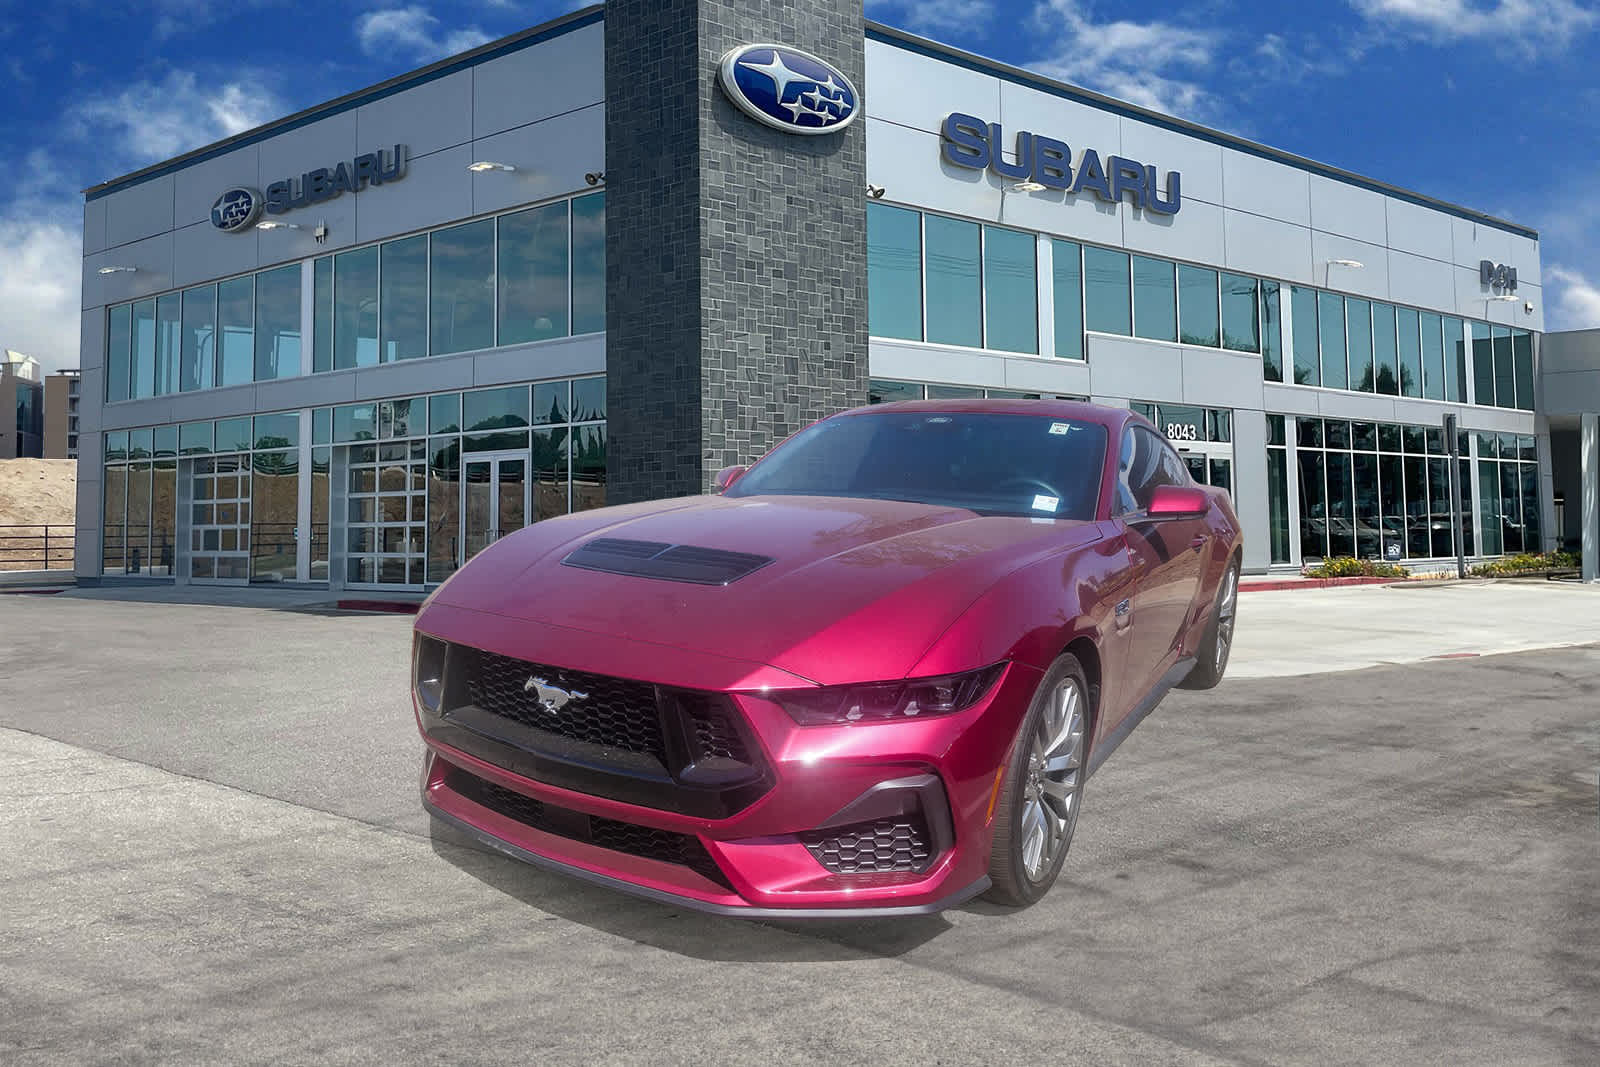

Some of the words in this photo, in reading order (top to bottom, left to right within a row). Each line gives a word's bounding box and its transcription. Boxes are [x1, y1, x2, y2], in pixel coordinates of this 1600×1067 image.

[266, 144, 407, 214] SUBARU
[941, 112, 1181, 215] SUBARU
[1167, 423, 1197, 440] 8043
